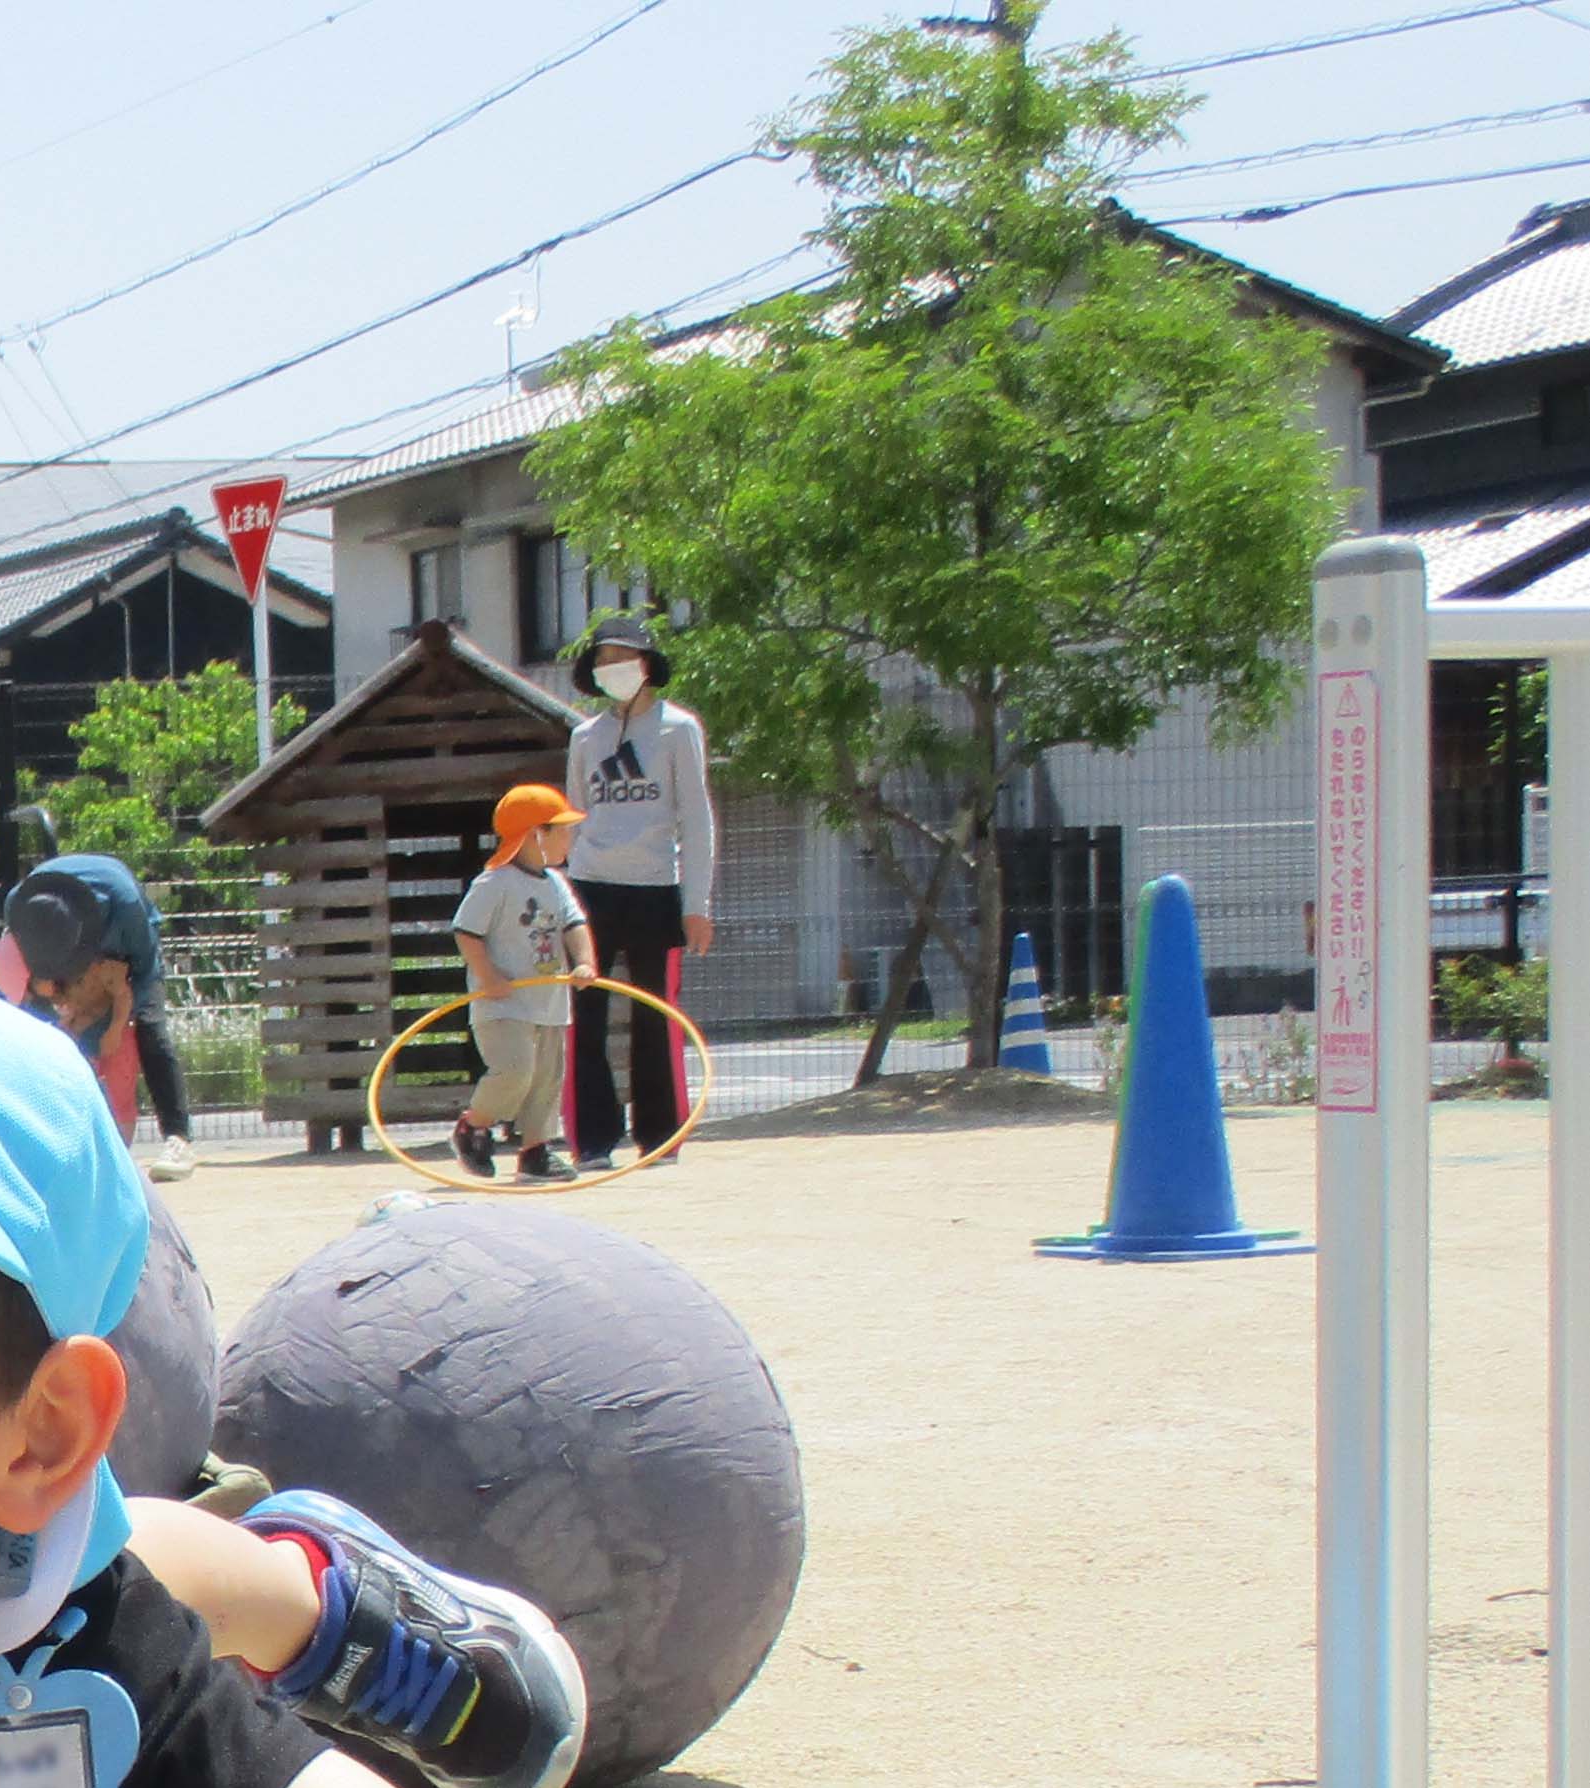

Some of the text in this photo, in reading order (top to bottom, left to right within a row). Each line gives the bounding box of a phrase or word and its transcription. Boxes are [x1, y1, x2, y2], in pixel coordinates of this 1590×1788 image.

[228, 502, 270, 533] 止まれ
[589, 780, 660, 803] didas
